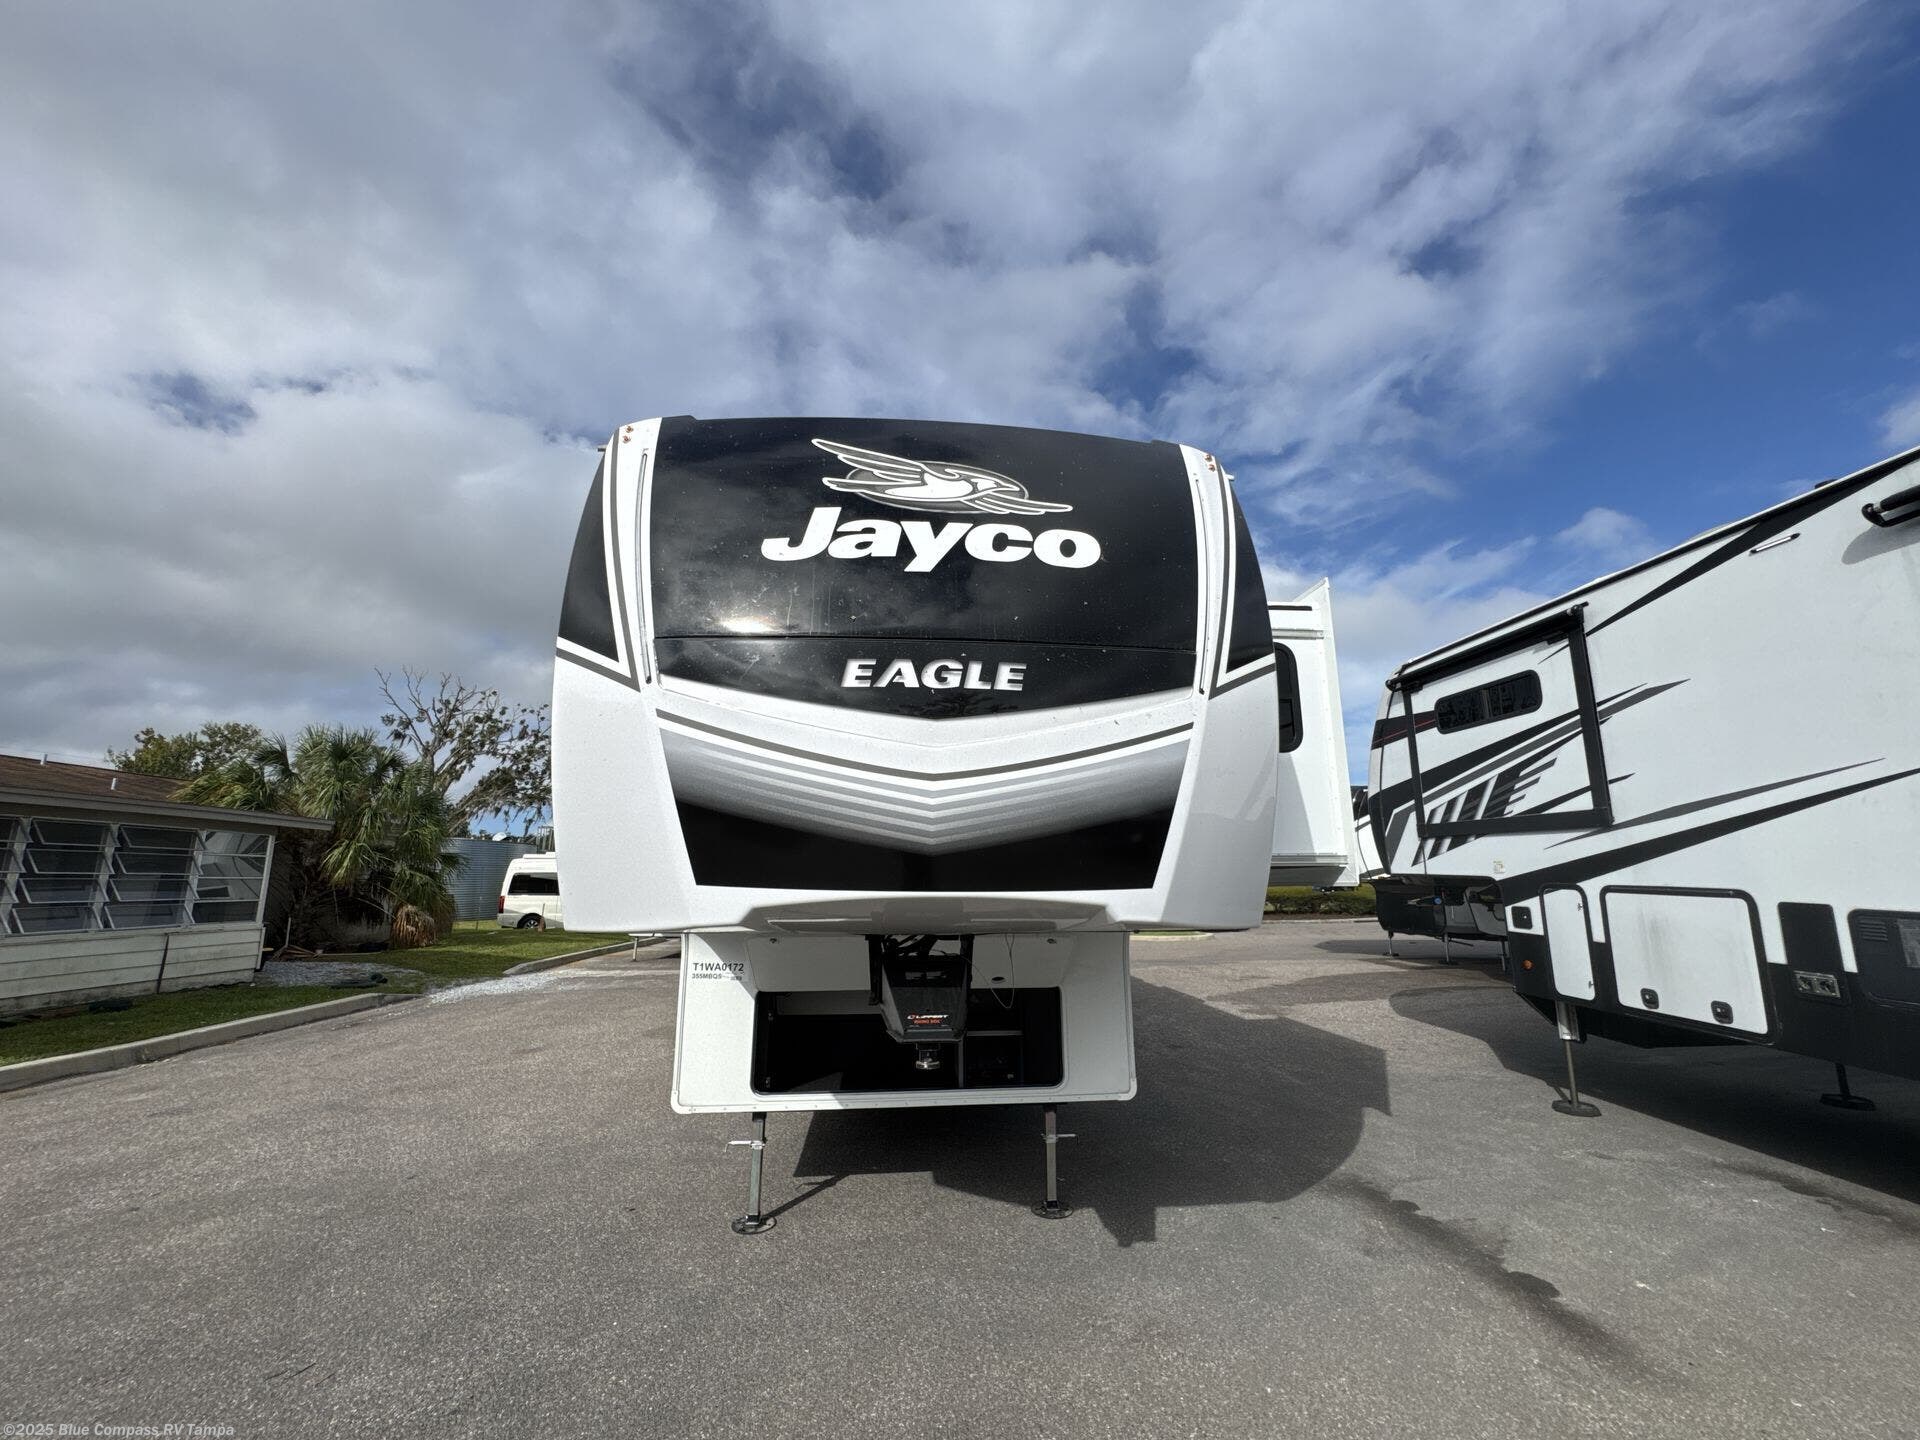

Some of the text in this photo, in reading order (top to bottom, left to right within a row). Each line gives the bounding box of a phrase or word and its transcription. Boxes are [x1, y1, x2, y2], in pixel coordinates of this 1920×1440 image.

[761, 506, 1102, 573] Jayco
[841, 658, 1027, 692] EAGLE
[693, 962, 744, 972] T1WA0172
